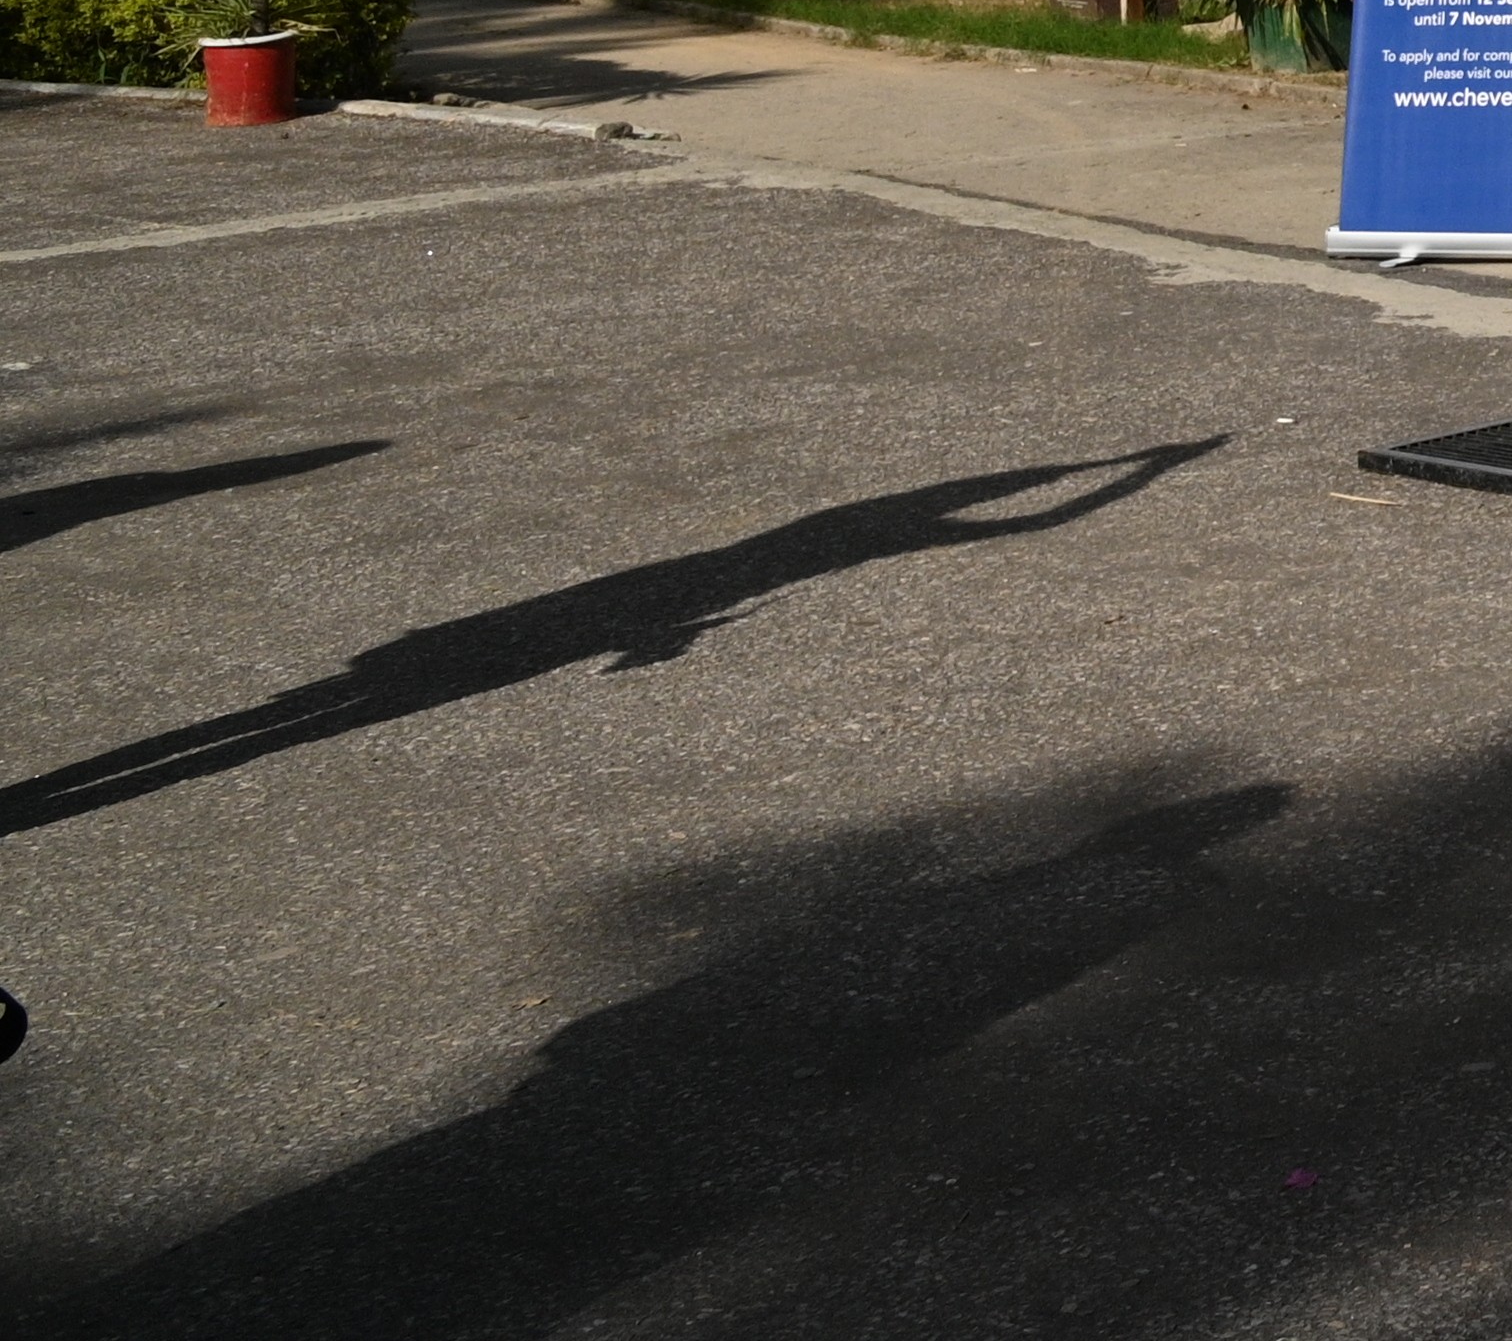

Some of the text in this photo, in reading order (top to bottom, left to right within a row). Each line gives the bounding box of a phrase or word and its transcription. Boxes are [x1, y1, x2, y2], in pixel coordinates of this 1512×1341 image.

[1414, 12, 1445, 26] until
[1450, 12, 1457, 25] 7
[1382, 50, 1396, 62] To
[1399, 50, 1433, 64] apply
[1437, 49, 1460, 62] and
[1463, 48, 1480, 62] for
[1424, 68, 1463, 82] please
[1467, 68, 1491, 79] visit
